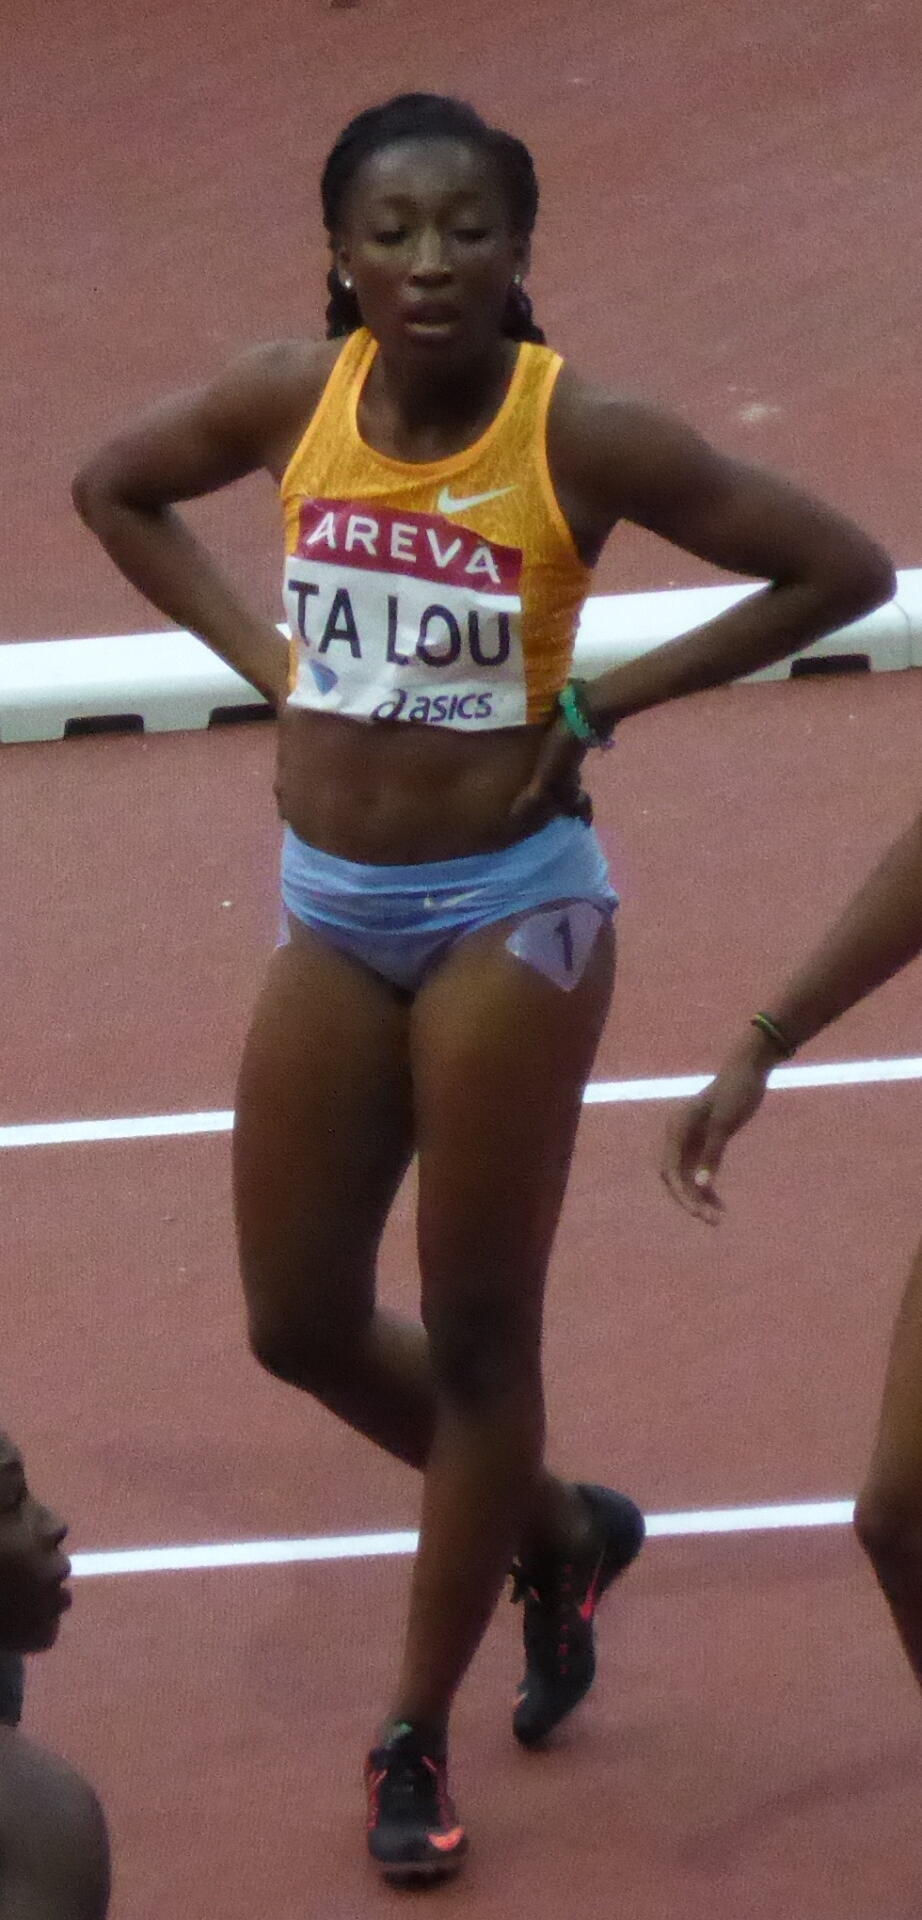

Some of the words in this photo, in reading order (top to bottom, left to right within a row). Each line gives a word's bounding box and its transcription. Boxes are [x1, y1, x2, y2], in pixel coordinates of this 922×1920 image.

[306, 511, 501, 584] AREVA
[288, 579, 362, 659] TA
[386, 595, 511, 668] LOU
[554, 915, 574, 972] 1
